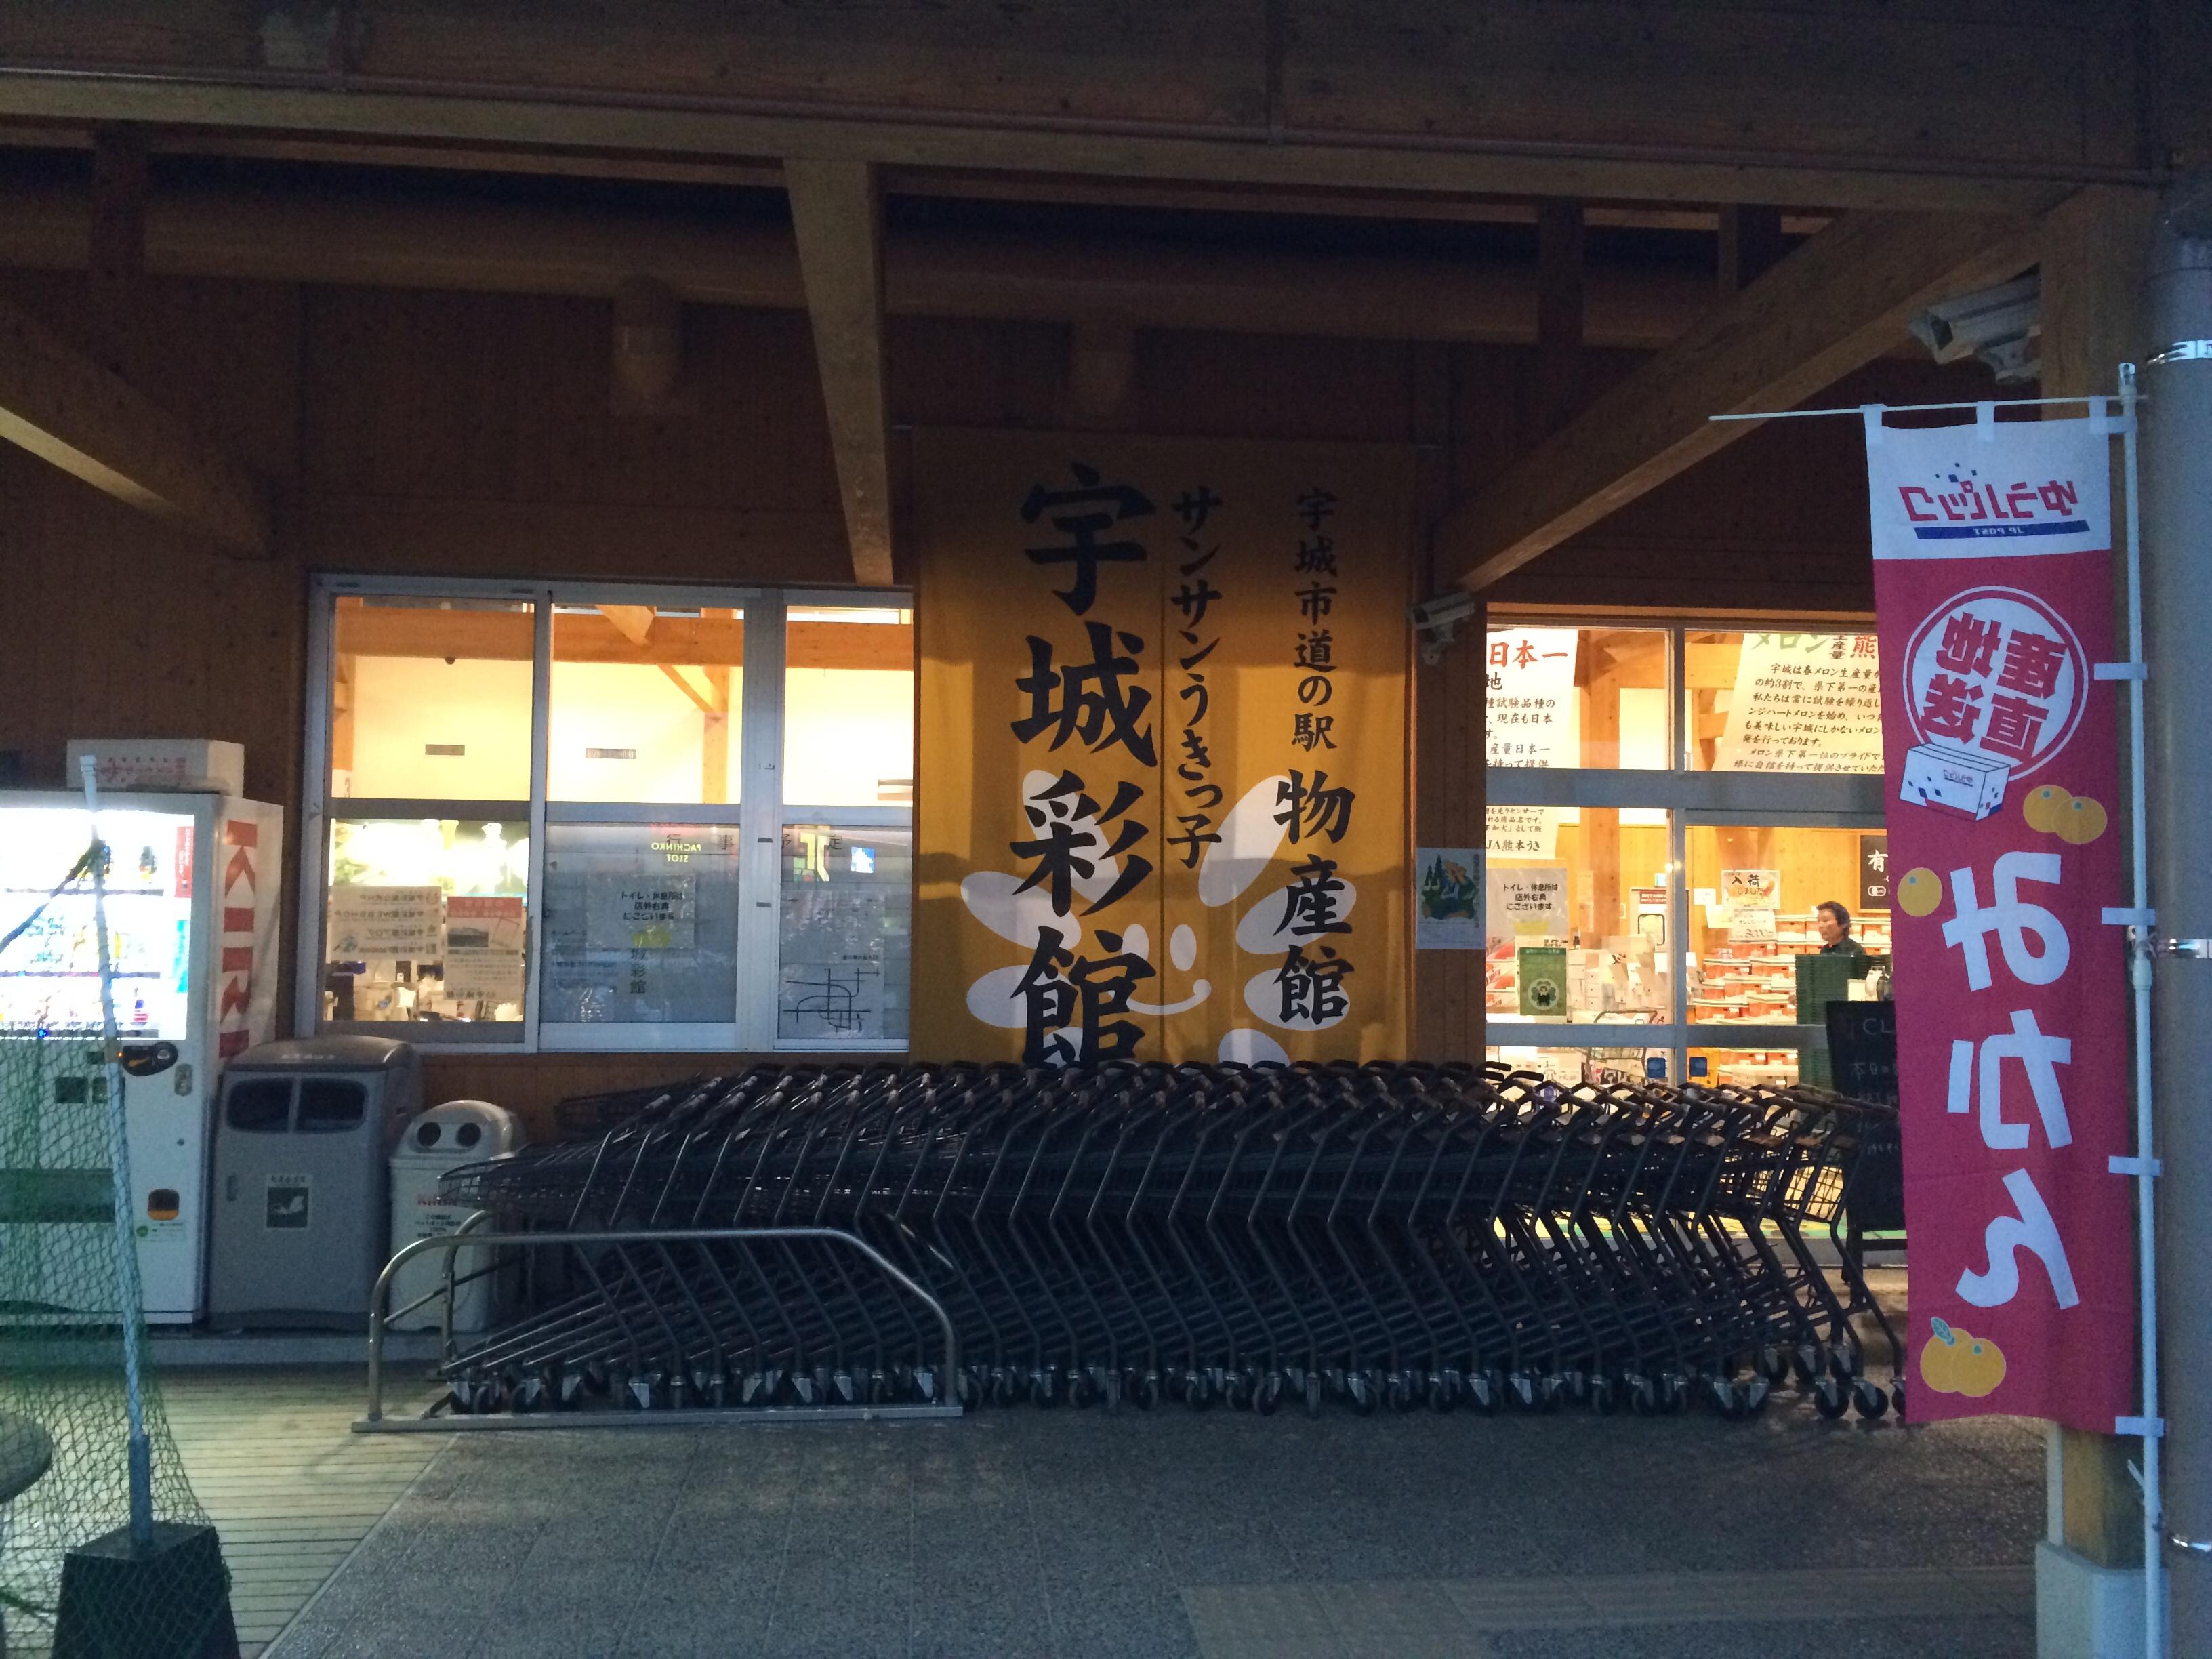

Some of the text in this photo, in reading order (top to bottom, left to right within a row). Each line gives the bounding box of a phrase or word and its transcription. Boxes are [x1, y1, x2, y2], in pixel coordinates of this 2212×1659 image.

[1167, 485, 1223, 869] サンサンうきっ子
[1273, 487, 1355, 1025] 宇城市道の駅 物産館
[1490, 639, 1568, 670] 日本一
[1750, 748, 1885, 762] メロン県下第一位のプライドで
[1755, 678, 1881, 695] の約3割で、県下第一の産
[1010, 462, 1160, 1067] 宇城彩館
